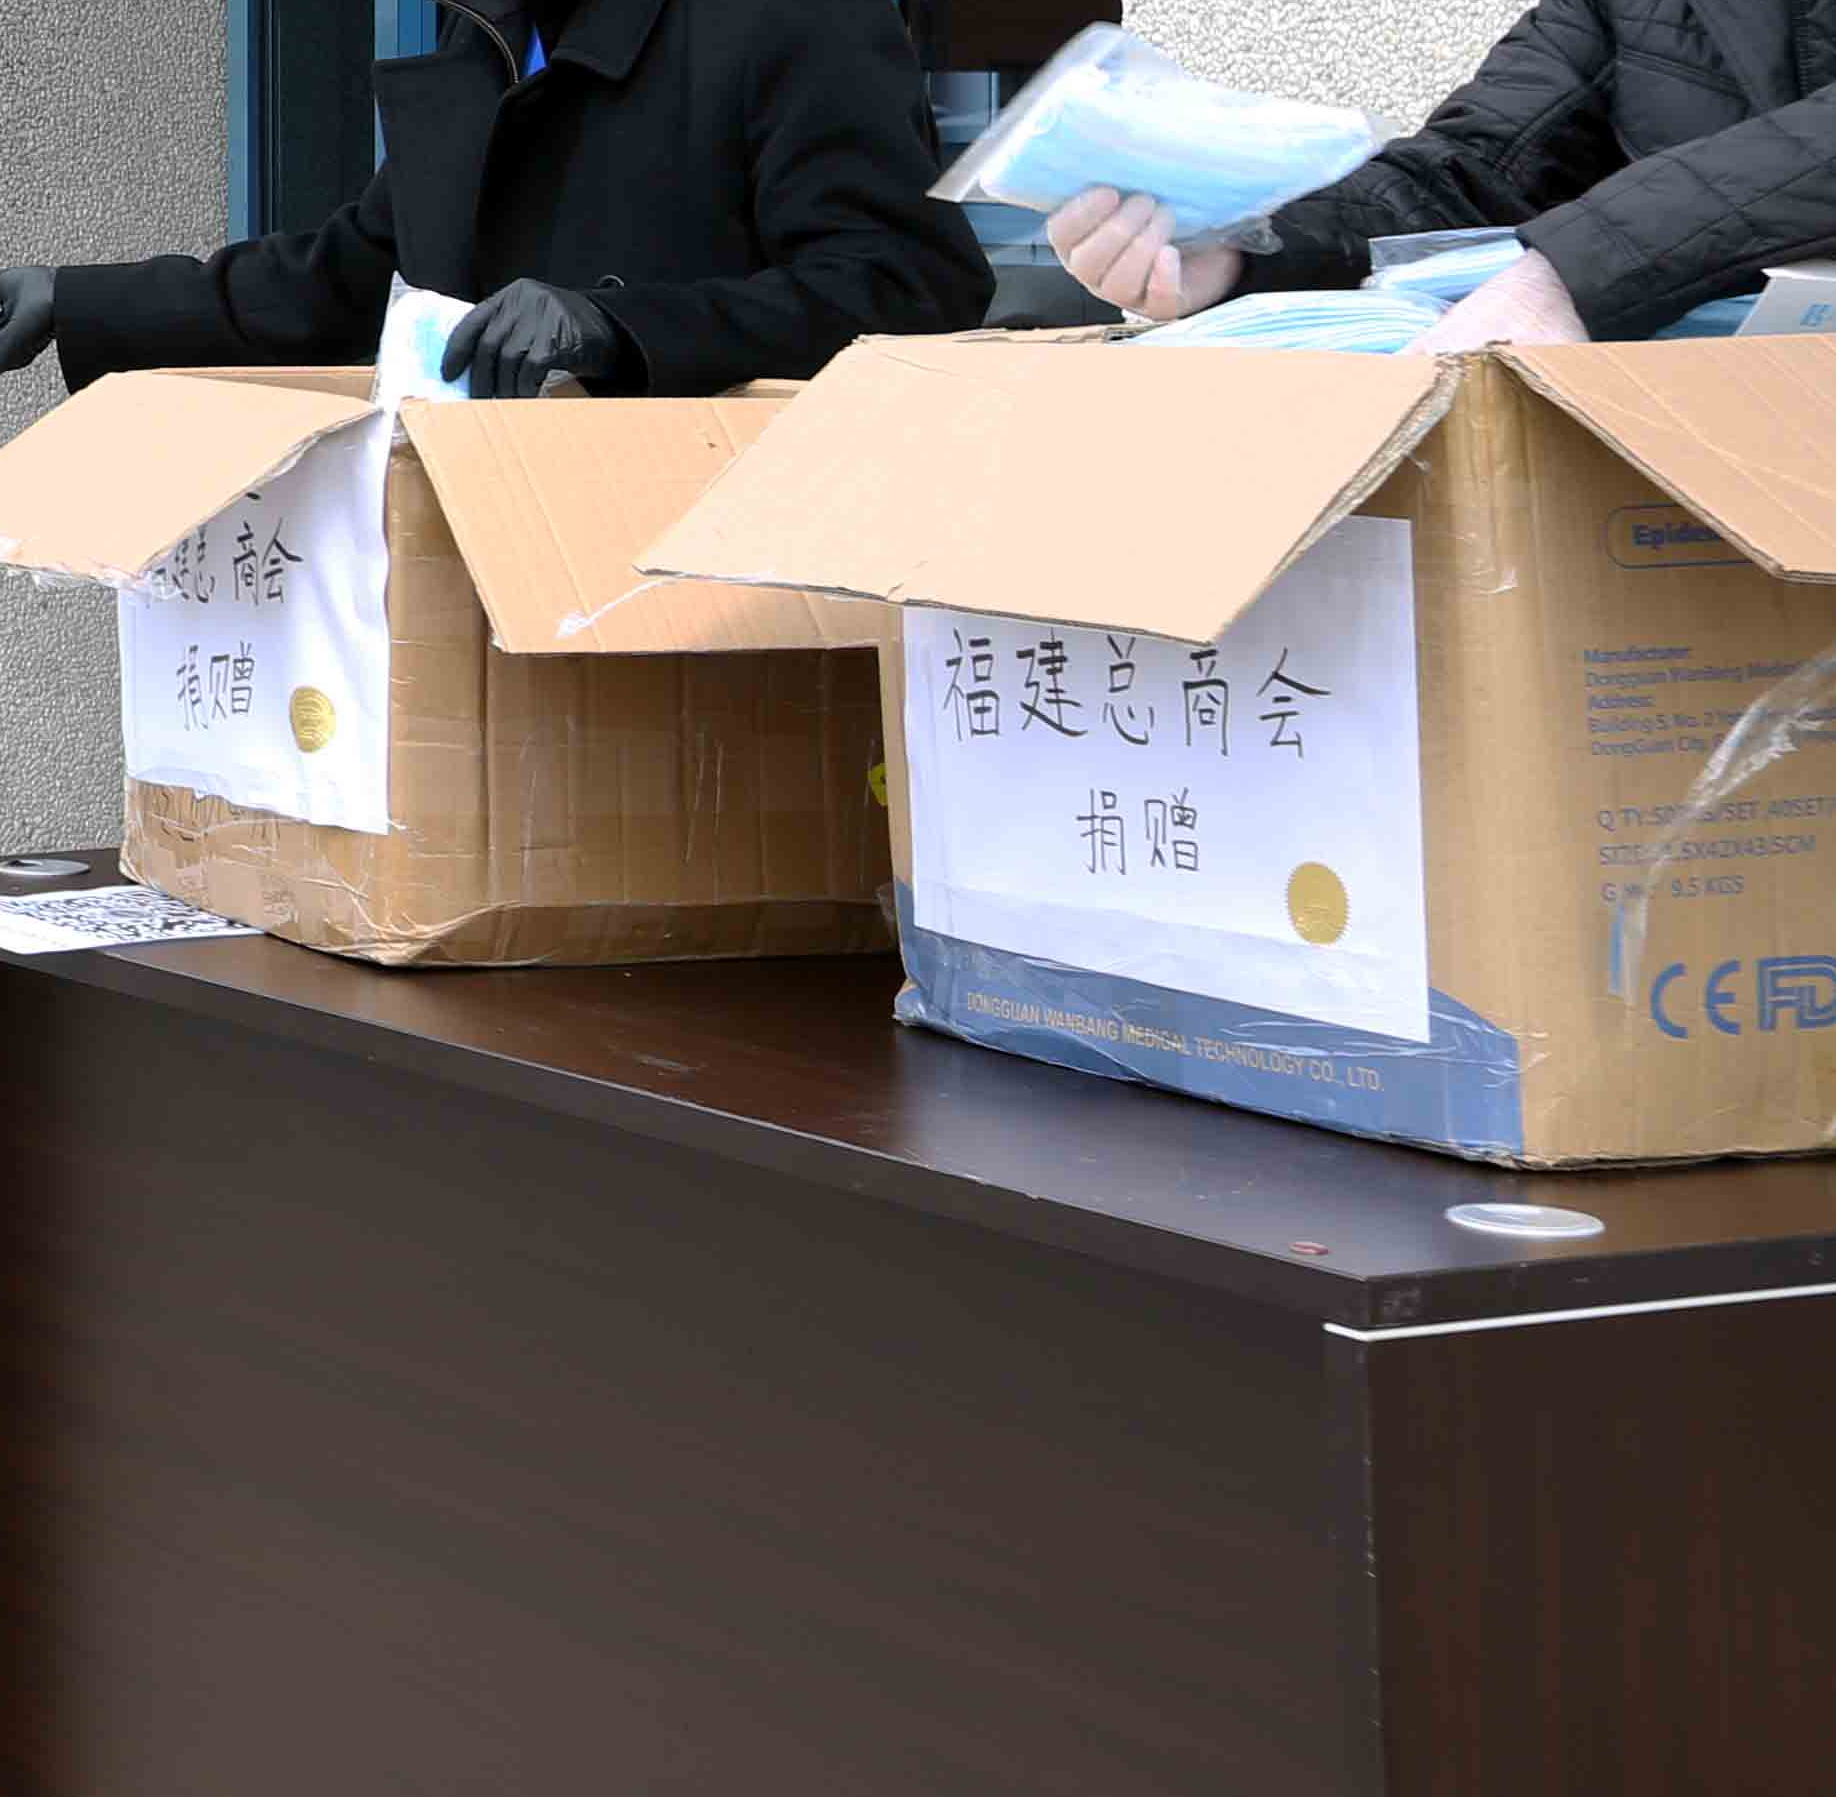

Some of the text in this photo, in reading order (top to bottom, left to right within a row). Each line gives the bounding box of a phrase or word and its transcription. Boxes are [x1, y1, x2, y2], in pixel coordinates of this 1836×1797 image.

[176, 640, 255, 731] 捐赠
[943, 627, 1332, 759] 福建总商会
[1076, 787, 1199, 875] 捐赠
[967, 991, 1041, 1026] DONGGUAN
[1045, 1007, 1119, 1041] WANBANG
[1121, 1018, 1191, 1056] MEDICAL
[1194, 1035, 1304, 1077] TECHNOLOGY
